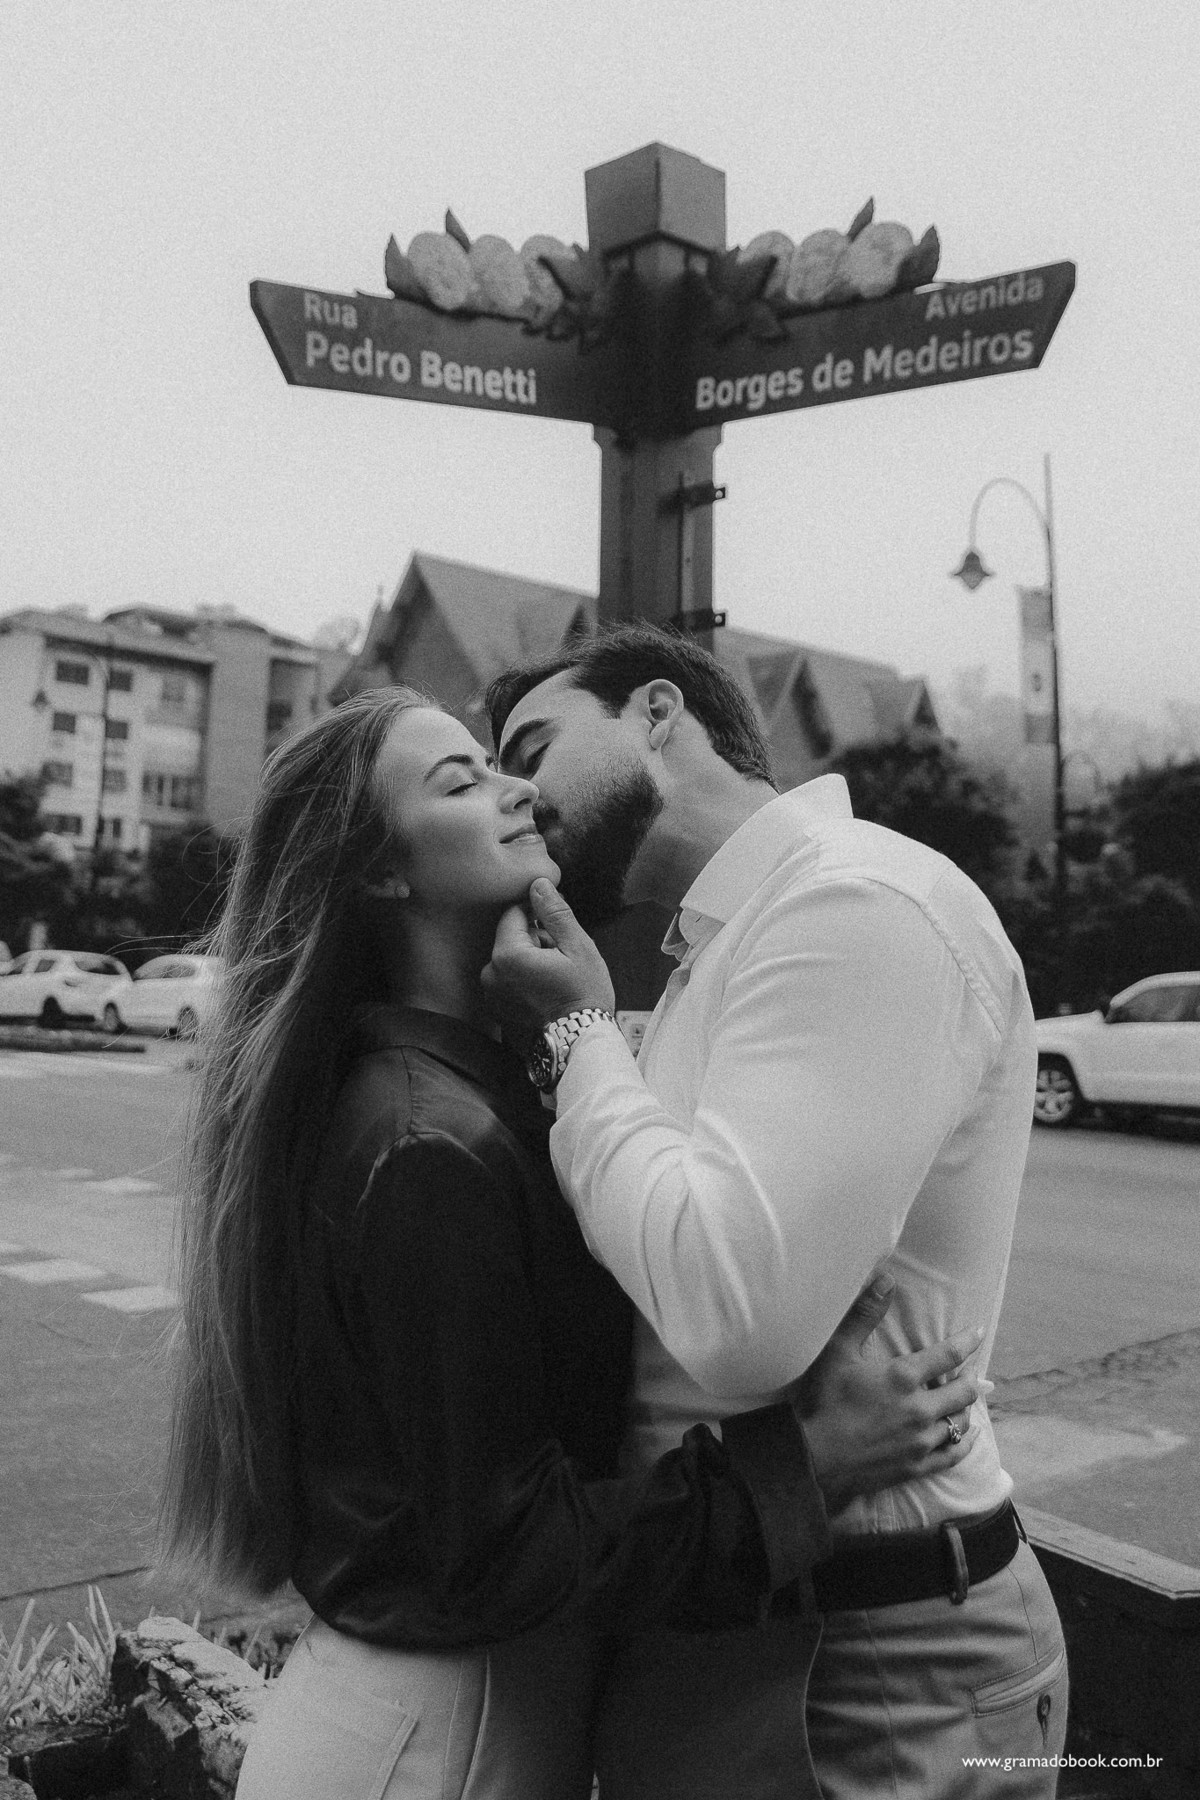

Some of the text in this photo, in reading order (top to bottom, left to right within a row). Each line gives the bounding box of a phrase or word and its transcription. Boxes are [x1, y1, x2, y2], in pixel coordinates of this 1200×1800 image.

[304, 291, 358, 330] Rua
[925, 272, 1044, 321] Avenida
[305, 330, 537, 405] Pedro Benetti
[695, 328, 1035, 411] Borges de Medeiros
